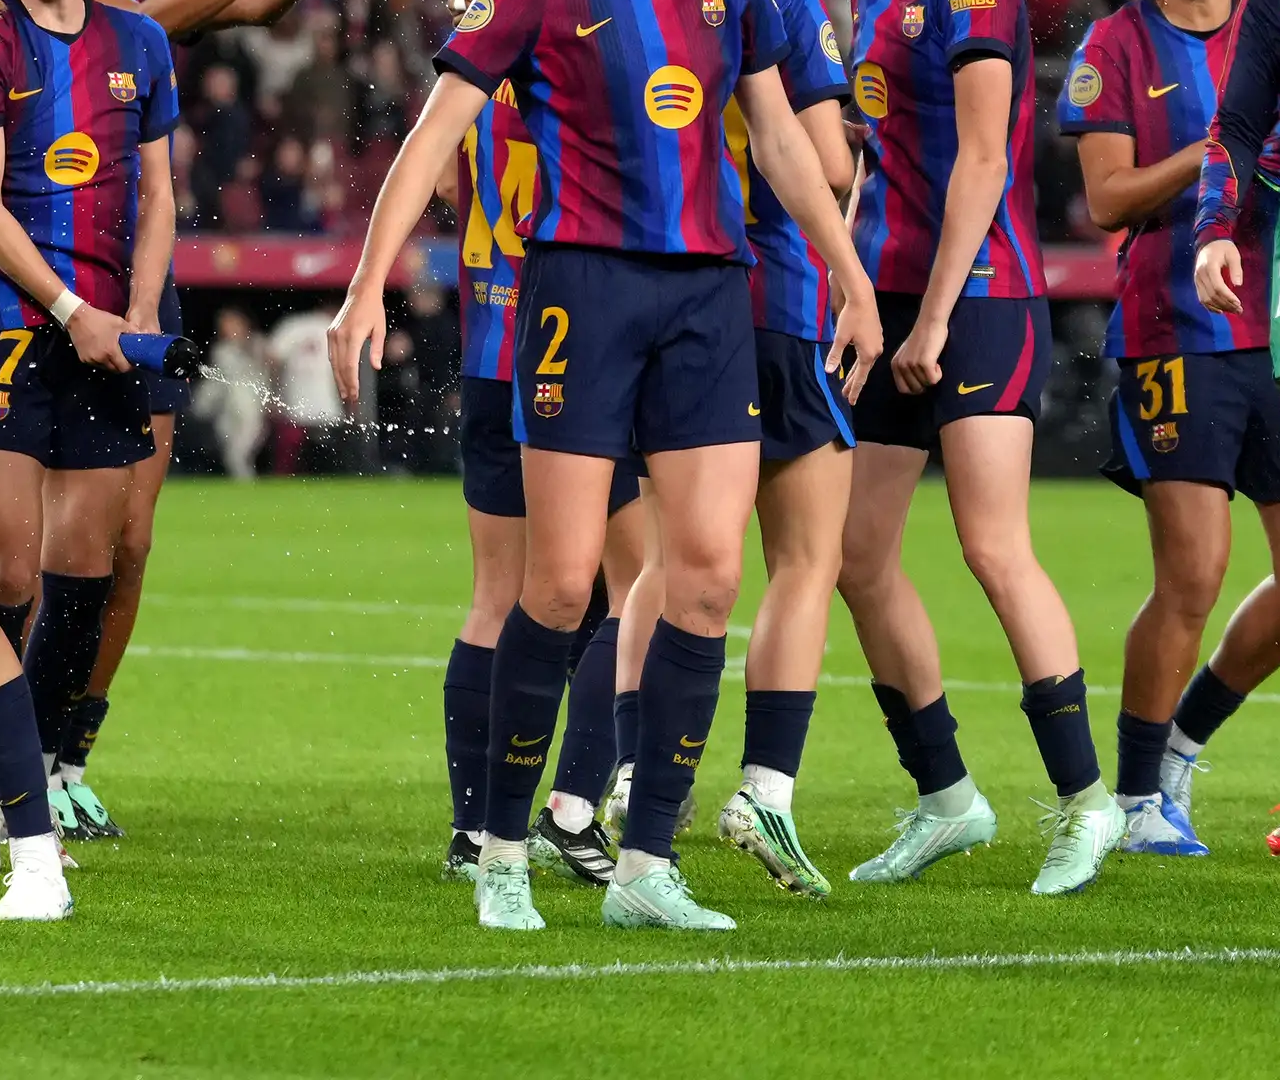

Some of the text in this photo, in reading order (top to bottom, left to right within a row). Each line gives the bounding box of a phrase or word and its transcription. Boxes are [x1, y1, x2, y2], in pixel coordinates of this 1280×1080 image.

[536, 307, 569, 375] 2
[1137, 356, 1189, 420] 31
[505, 752, 543, 767] BARÇA
